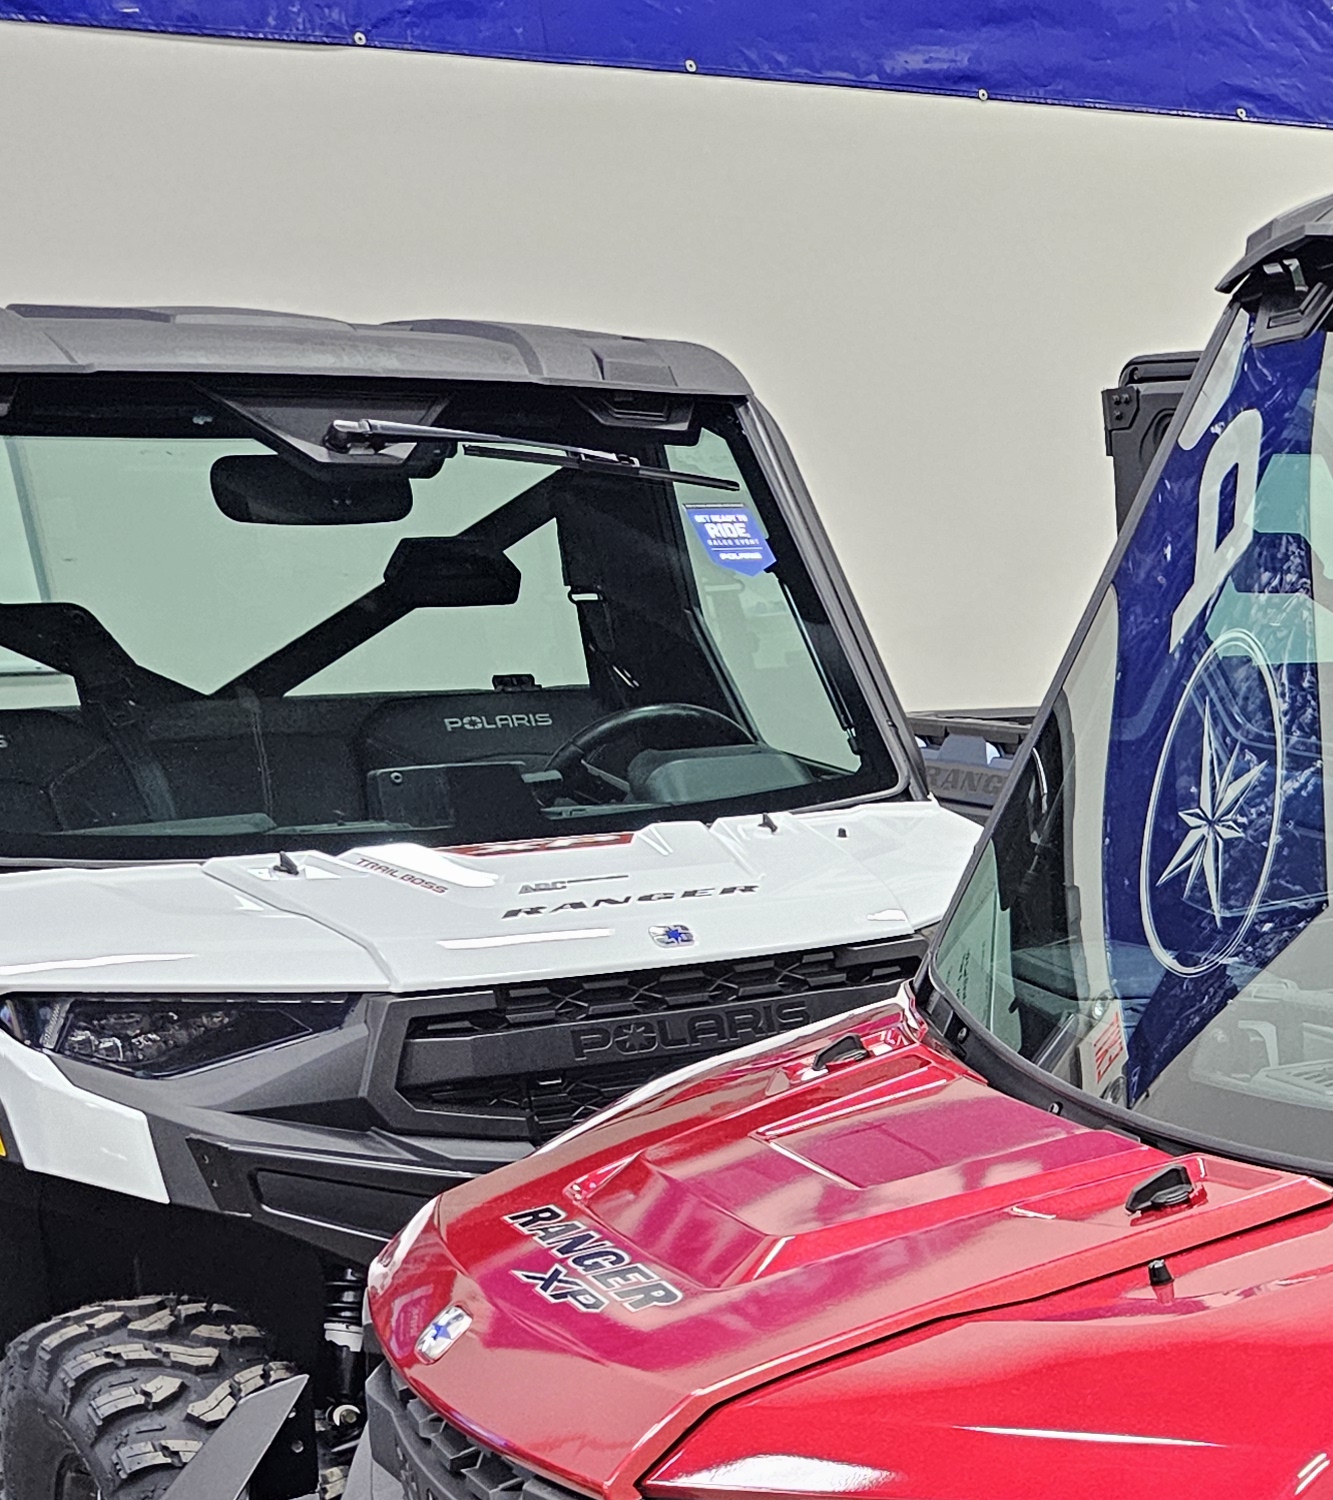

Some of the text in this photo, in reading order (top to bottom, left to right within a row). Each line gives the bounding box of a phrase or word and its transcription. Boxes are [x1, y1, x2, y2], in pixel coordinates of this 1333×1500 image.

[704, 523, 751, 538] RIDE
[443, 713, 553, 732] POLARIS
[356, 858, 449, 894] TRAIL BOSS
[501, 884, 760, 919] RANGER
[571, 1001, 811, 1061] POLARIS
[502, 1204, 684, 1312] RANGER
[510, 1263, 609, 1313] XP
